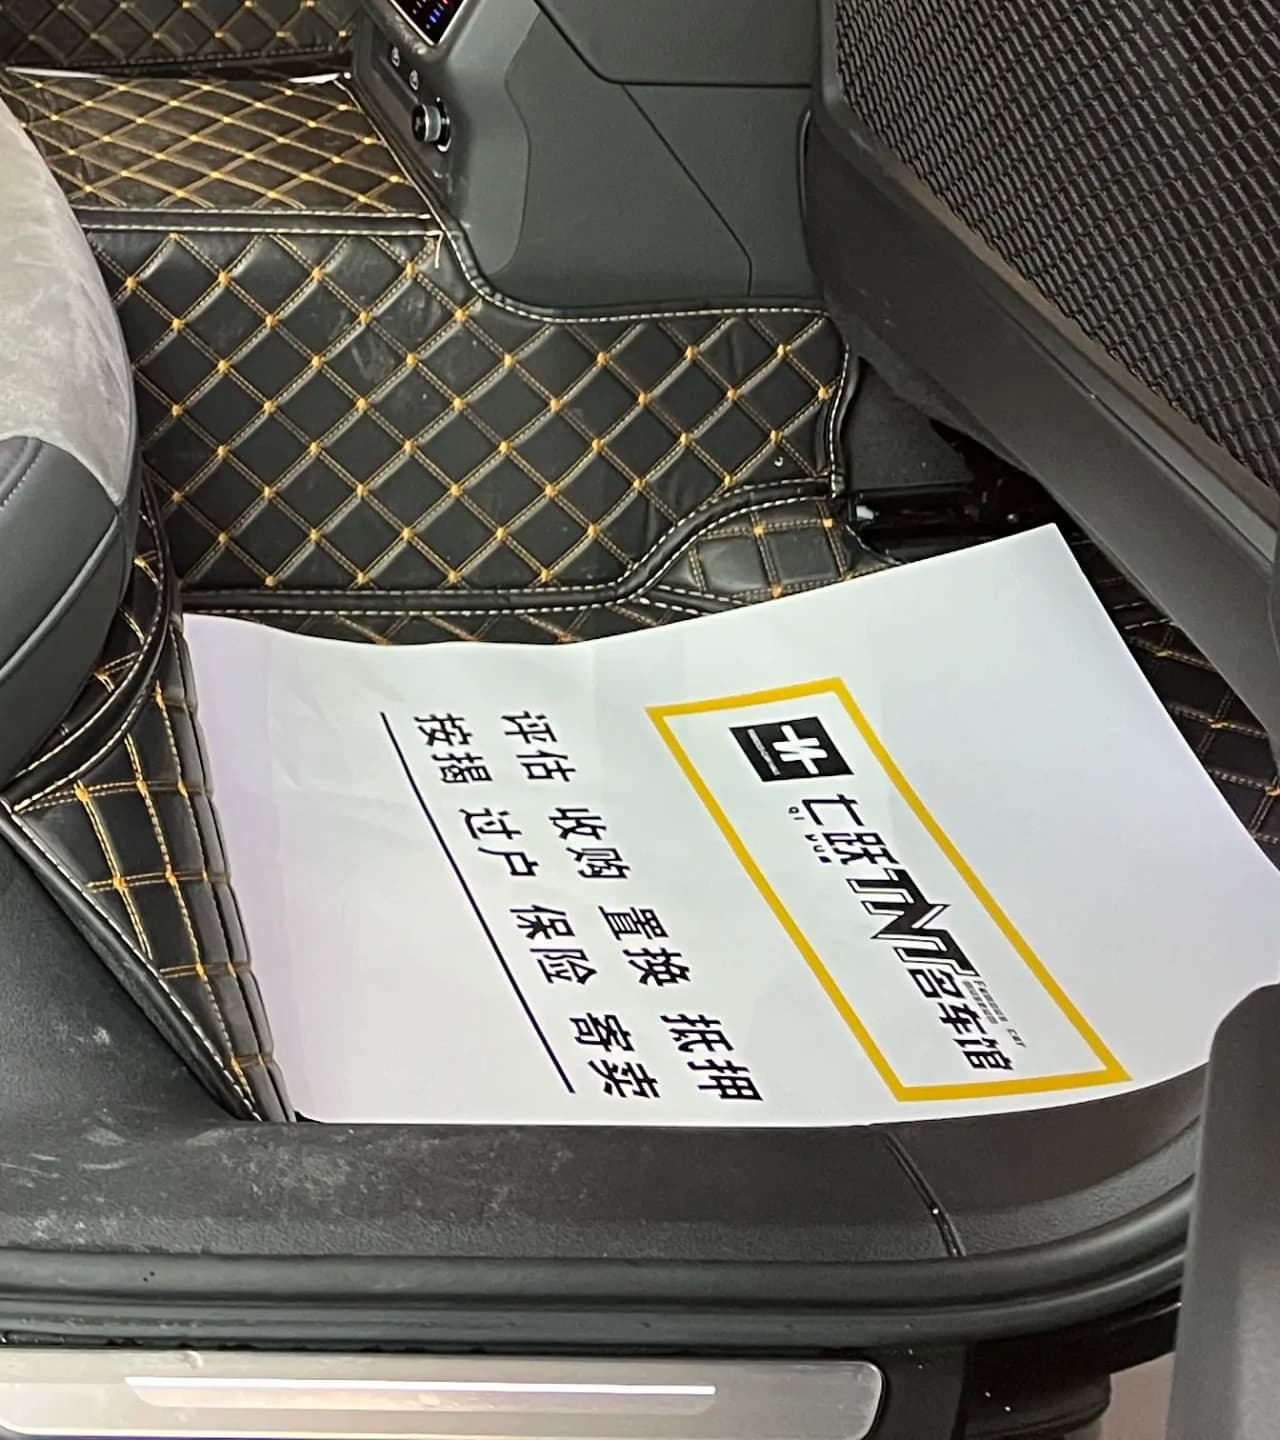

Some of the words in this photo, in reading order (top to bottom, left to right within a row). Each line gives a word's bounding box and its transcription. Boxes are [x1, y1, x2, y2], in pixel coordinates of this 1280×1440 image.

[413, 713, 493, 784] 按揭
[459, 807, 540, 877] 过户
[509, 904, 598, 985] 保险
[569, 1012, 661, 1098] 寄卖
[501, 710, 576, 782] 评估
[548, 807, 631, 879] 收购
[598, 905, 692, 987] 置换
[659, 1013, 764, 1101] 抵押
[1007, 1028, 1028, 1049] car
